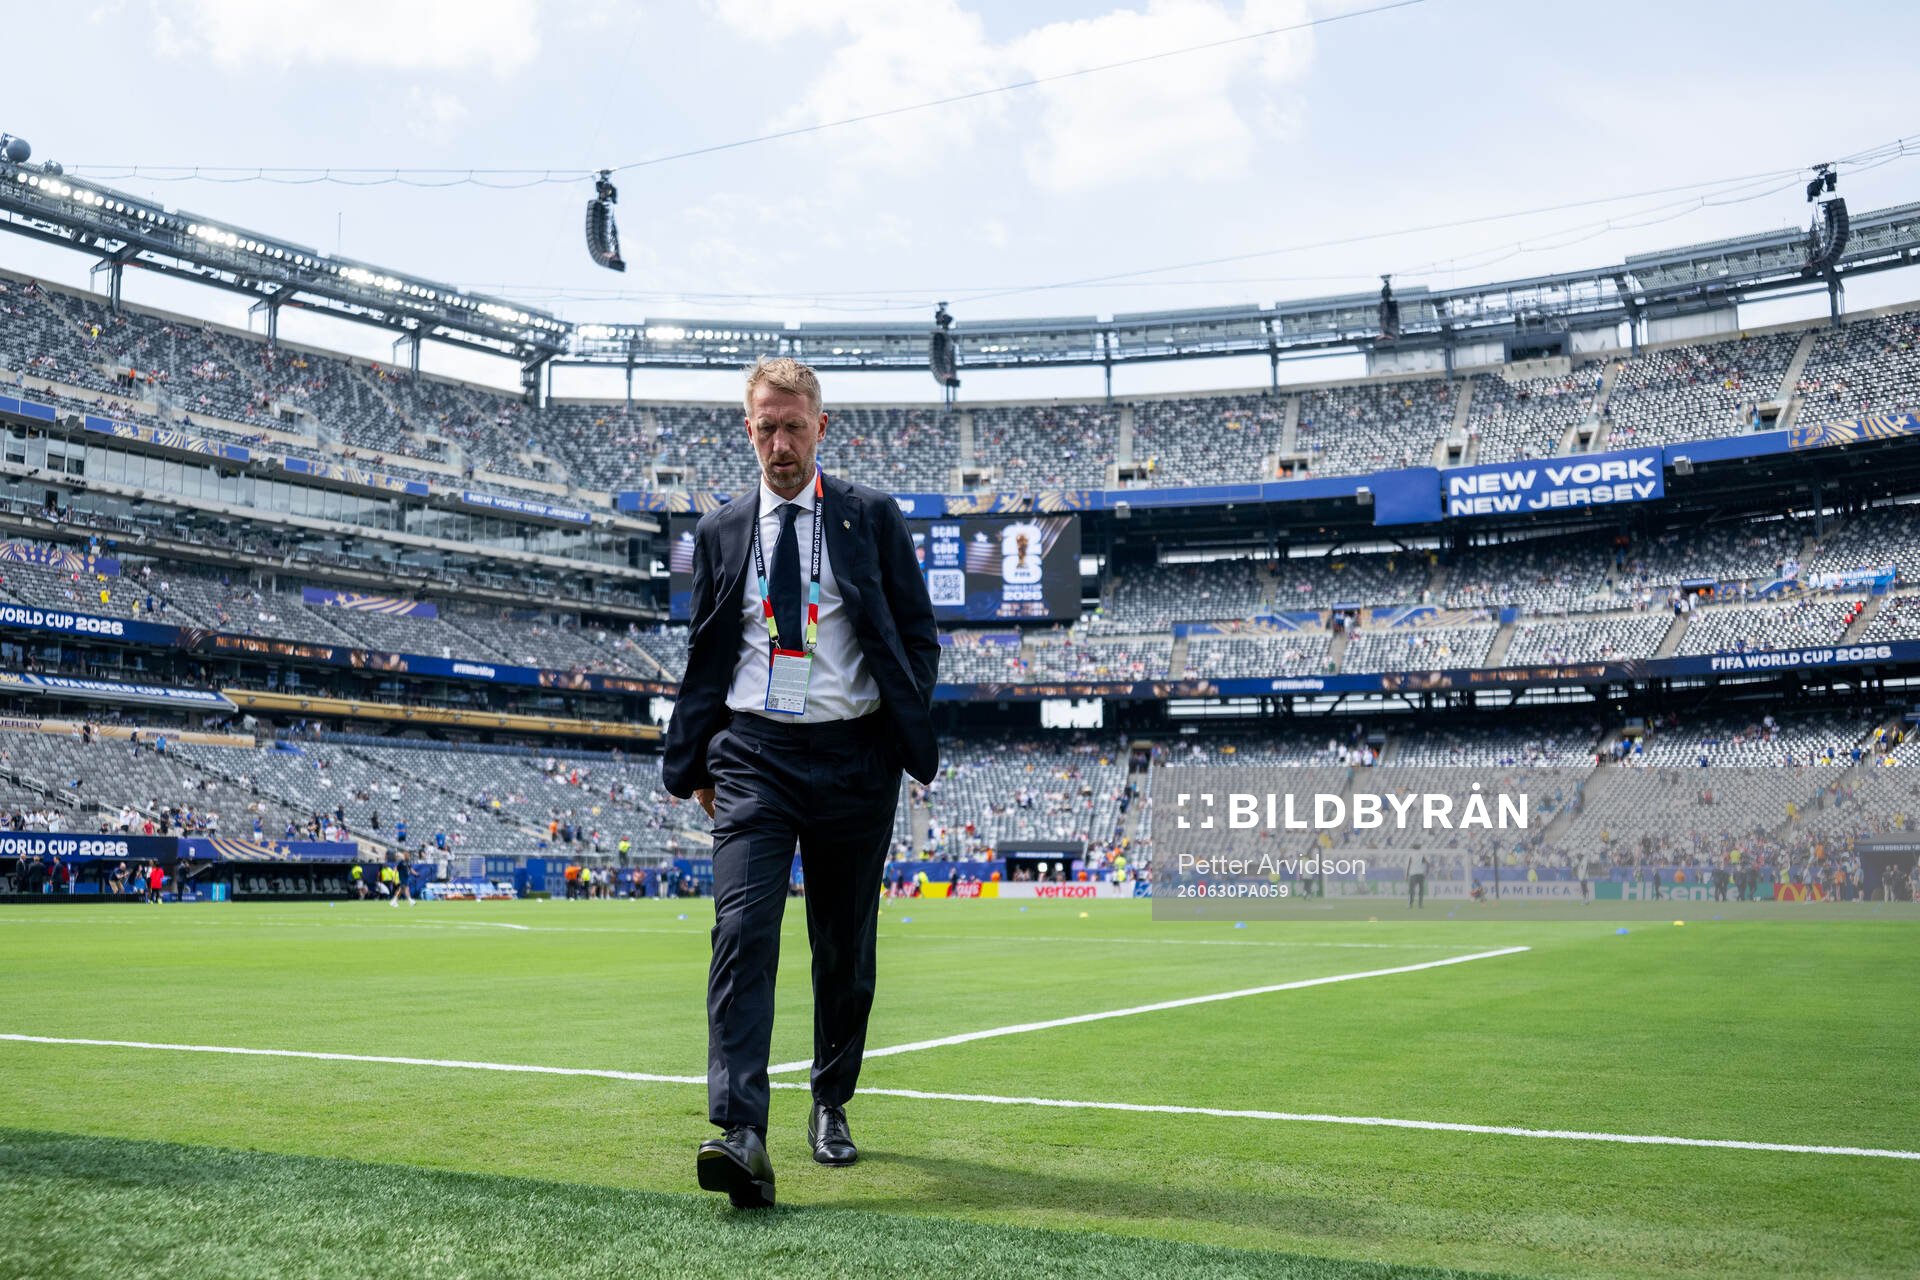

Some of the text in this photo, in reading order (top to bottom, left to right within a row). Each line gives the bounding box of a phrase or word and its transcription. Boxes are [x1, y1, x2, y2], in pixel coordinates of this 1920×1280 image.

[1450, 457, 1656, 496] NEW YORK
[1451, 481, 1656, 516] NEW JERSEY
[755, 556, 763, 571] FIFA
[45, 613, 74, 629] CUP
[75, 617, 124, 636] 2026
[1711, 645, 1892, 671] FIFA WORLD CUP 2026
[0, 838, 128, 857] ORLD CUP 2026
[1034, 881, 1097, 898] verizon
[1502, 885, 1571, 896] AMERICA
